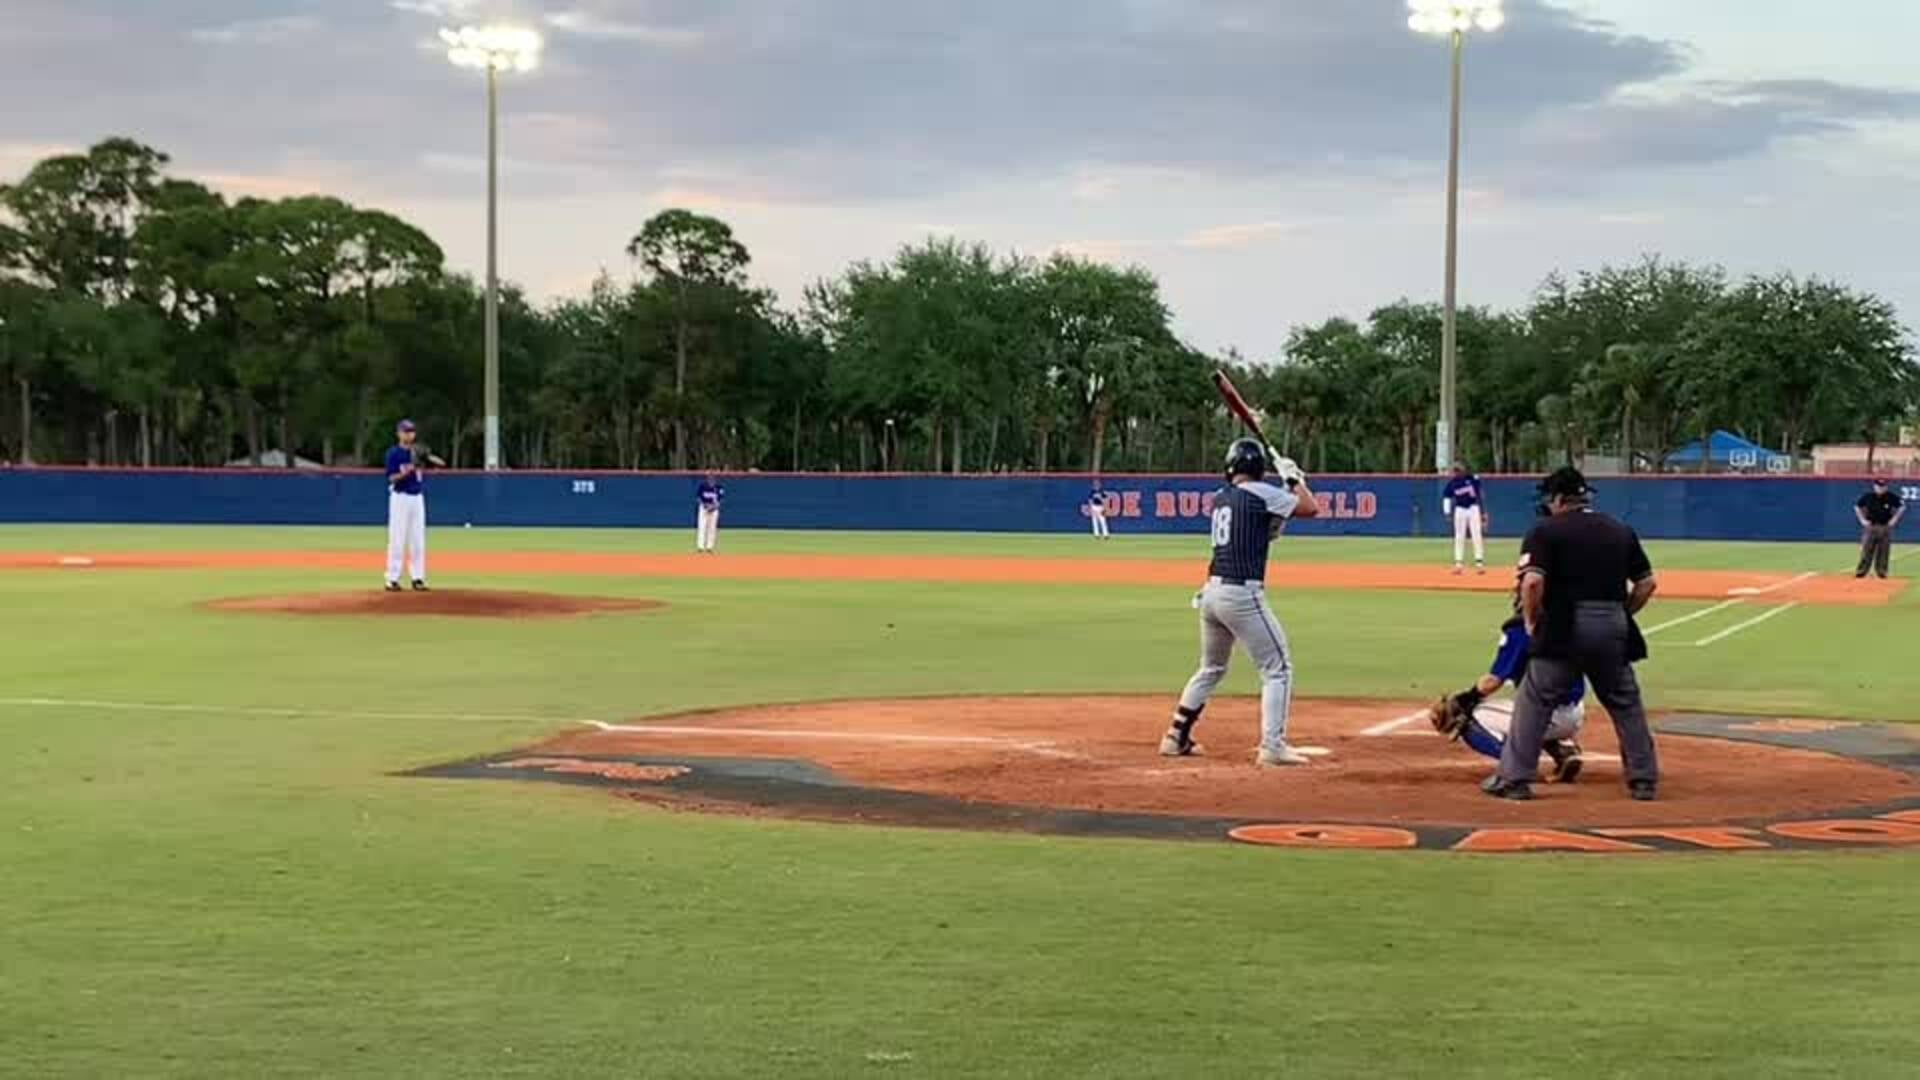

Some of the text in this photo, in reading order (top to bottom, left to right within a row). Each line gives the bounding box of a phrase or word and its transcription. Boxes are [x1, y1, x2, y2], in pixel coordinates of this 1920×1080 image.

[1155, 491, 1217, 517] RUS
[1313, 491, 1377, 518] ELD
[1211, 505, 1232, 547] 18
[1228, 810, 1920, 851] GATO
